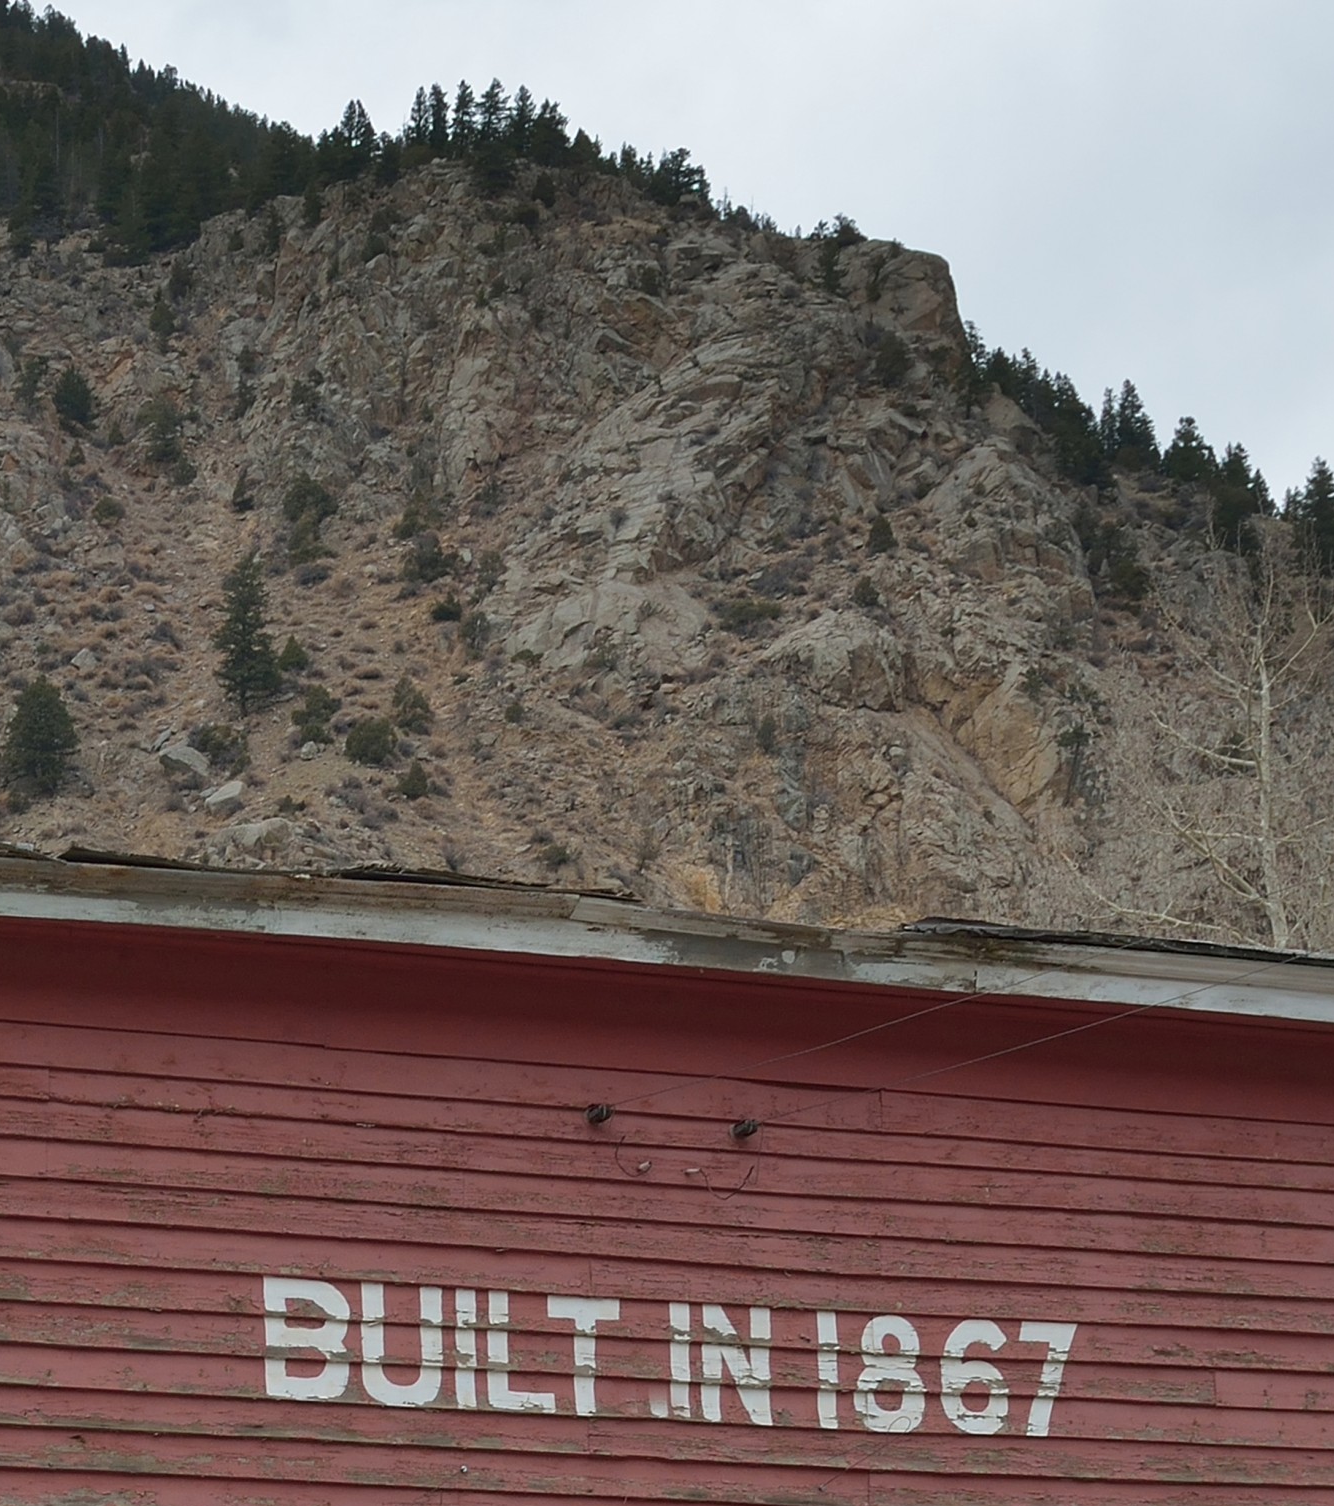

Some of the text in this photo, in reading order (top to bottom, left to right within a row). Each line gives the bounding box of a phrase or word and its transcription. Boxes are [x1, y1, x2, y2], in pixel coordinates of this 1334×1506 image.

[263, 1277, 1078, 1436] BUILT IN 1867
